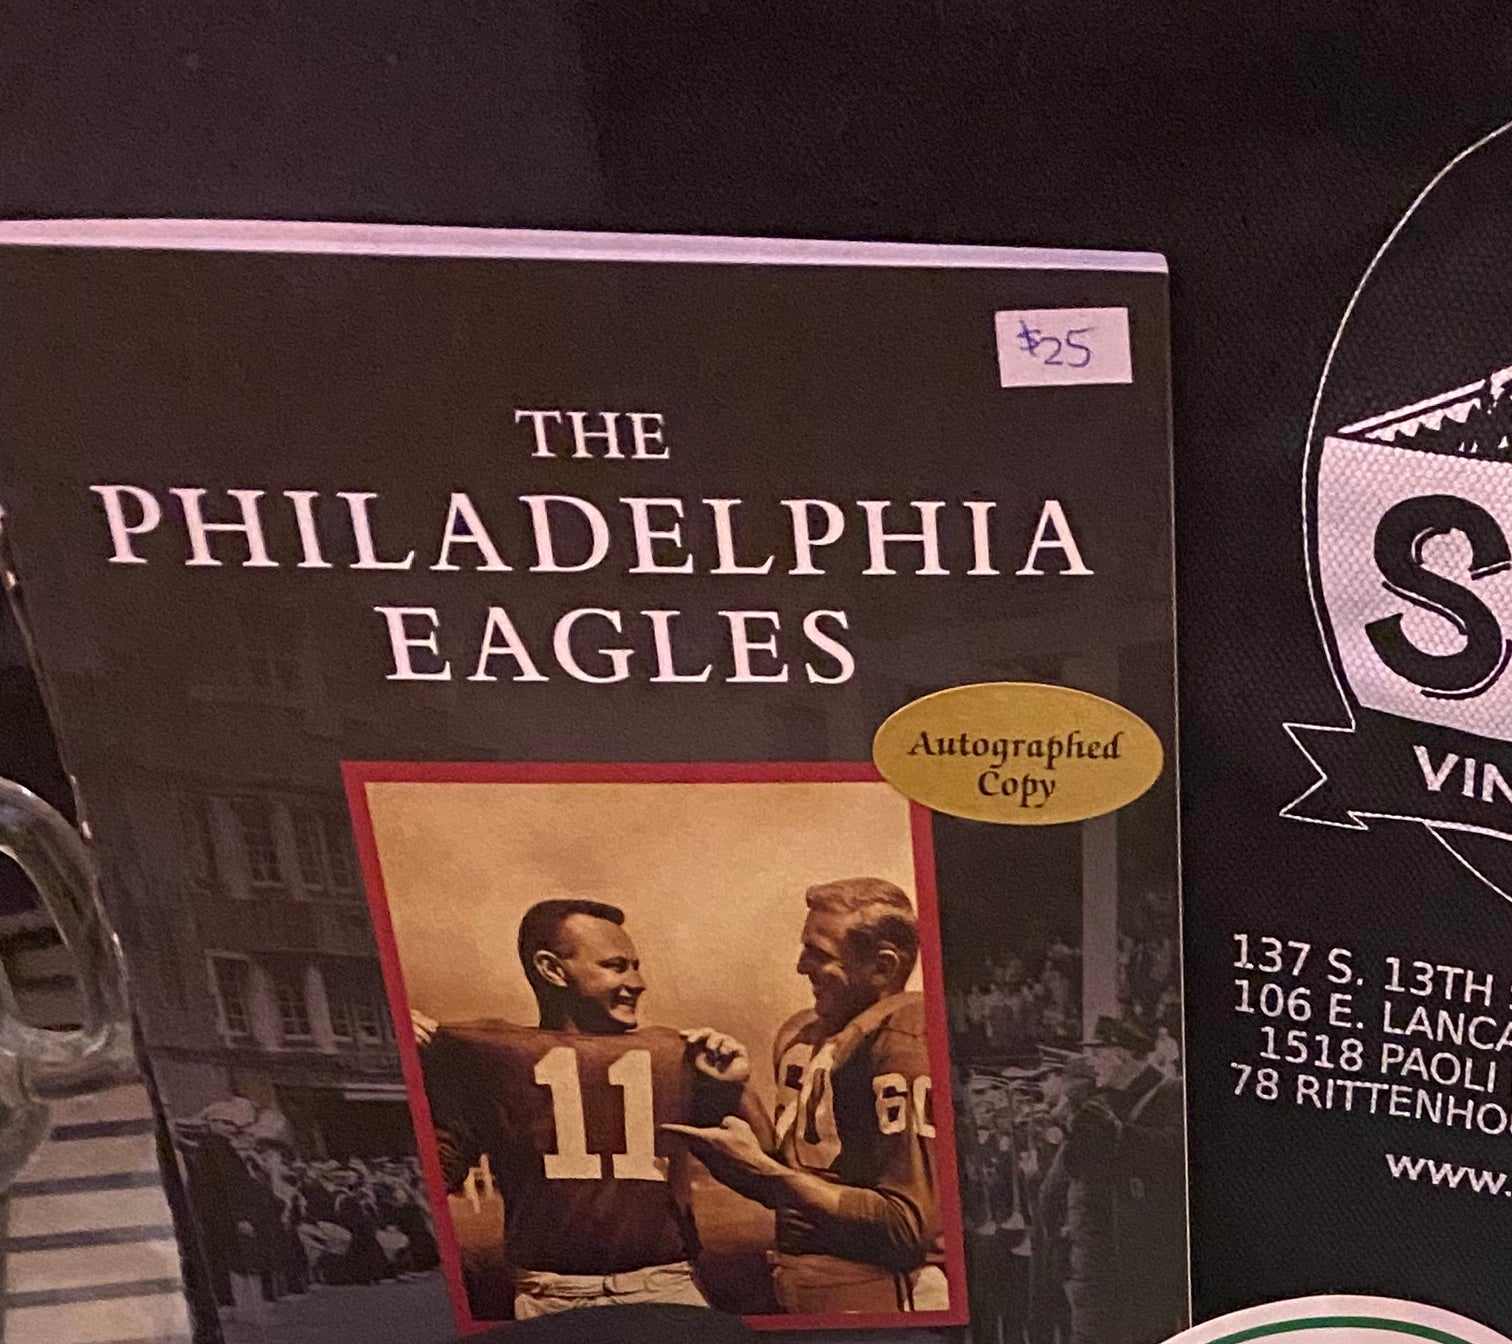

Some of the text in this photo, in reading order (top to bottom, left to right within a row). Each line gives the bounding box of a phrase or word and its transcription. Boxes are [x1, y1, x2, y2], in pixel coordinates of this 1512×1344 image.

[1016, 319, 1095, 368] $25
[514, 409, 671, 460] THE
[90, 484, 1095, 577] PHILADELPHIA
[374, 605, 858, 686] EAGLES
[907, 730, 1125, 770] Autographed
[977, 770, 1056, 809] Copy
[1233, 933, 1312, 977] 137
[1327, 948, 1364, 986] S.
[1384, 957, 1494, 1007] 13TH
[1233, 979, 1312, 1021] 106
[1328, 995, 1364, 1029] E.
[1230, 1062, 1280, 1101] 78
[1259, 1026, 1364, 1072] 1518
[1381, 1042, 1495, 1093] PAOLI
[534, 1047, 669, 1182] 11
